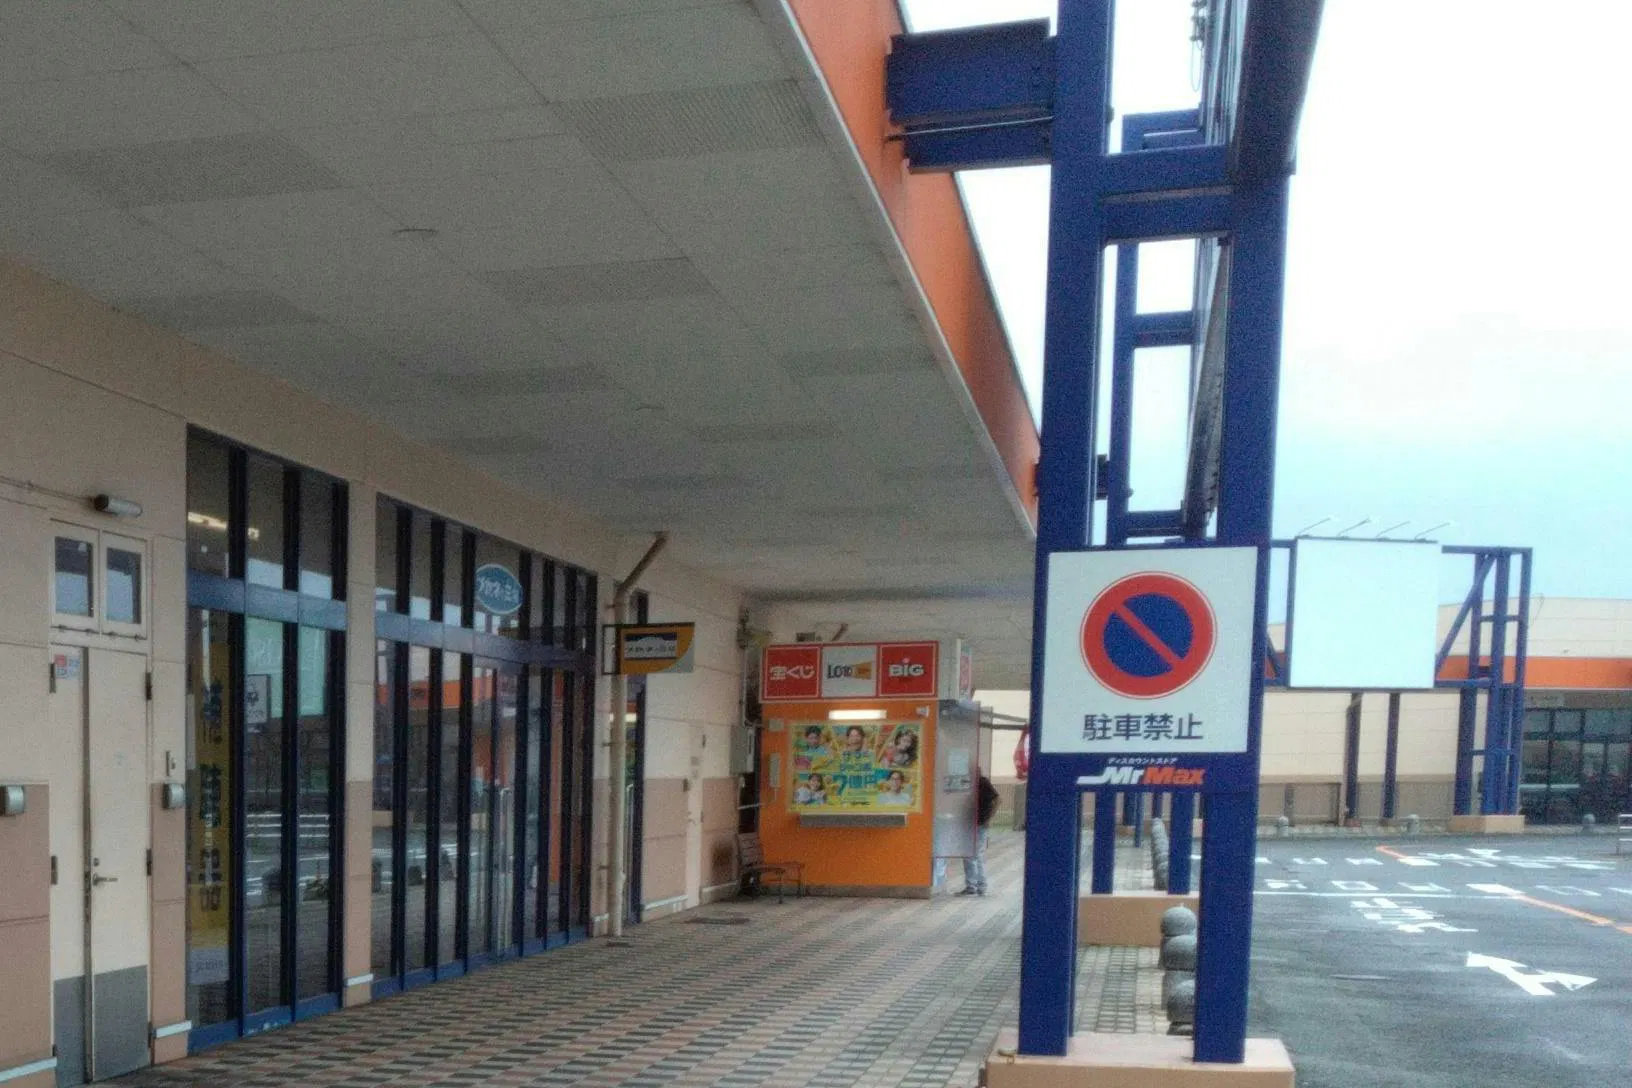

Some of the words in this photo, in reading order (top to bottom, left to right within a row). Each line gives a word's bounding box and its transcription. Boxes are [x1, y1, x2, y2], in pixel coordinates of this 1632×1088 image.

[770, 664, 815, 681] 宝くじ
[1082, 712, 1204, 741] 駐車禁止
